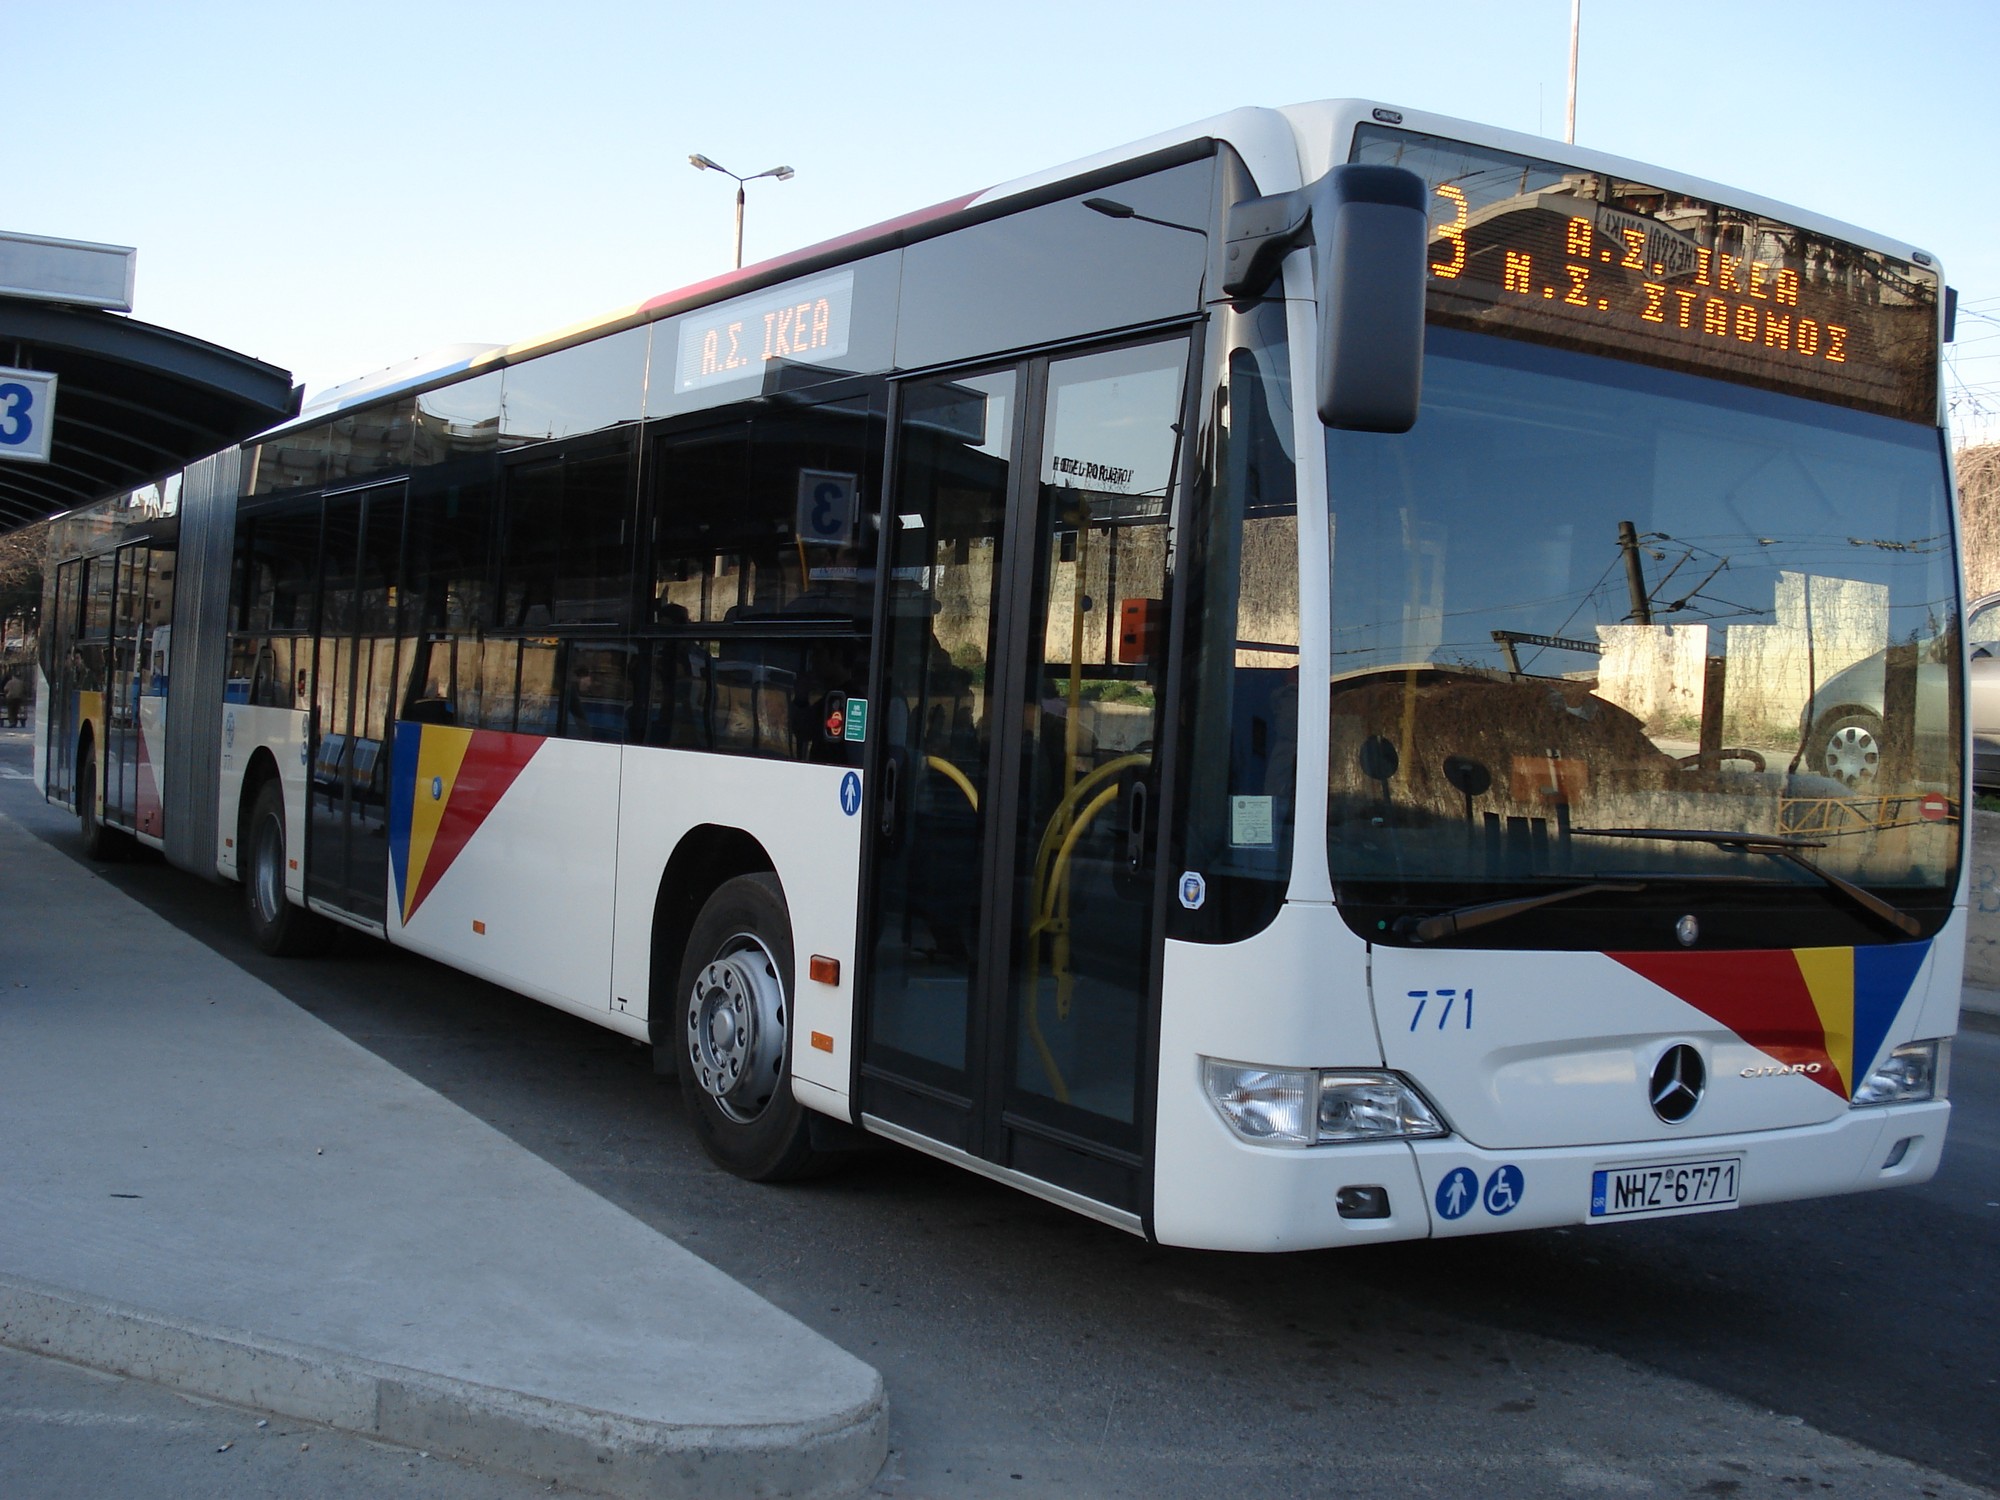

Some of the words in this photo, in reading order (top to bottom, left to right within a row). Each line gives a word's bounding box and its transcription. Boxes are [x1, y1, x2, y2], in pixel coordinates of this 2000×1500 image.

[1431, 185, 1468, 279] 3
[1695, 248, 1798, 306] IKEA
[761, 298, 829, 360] IKEA
[1641, 281, 1848, 363] ΣΤΑΘΜΟΣ
[0, 383, 33, 445] 3
[1407, 988, 1473, 1032] 771
[1740, 1063, 1822, 1078] CITARO
[1593, 1197, 1605, 1207] GR
